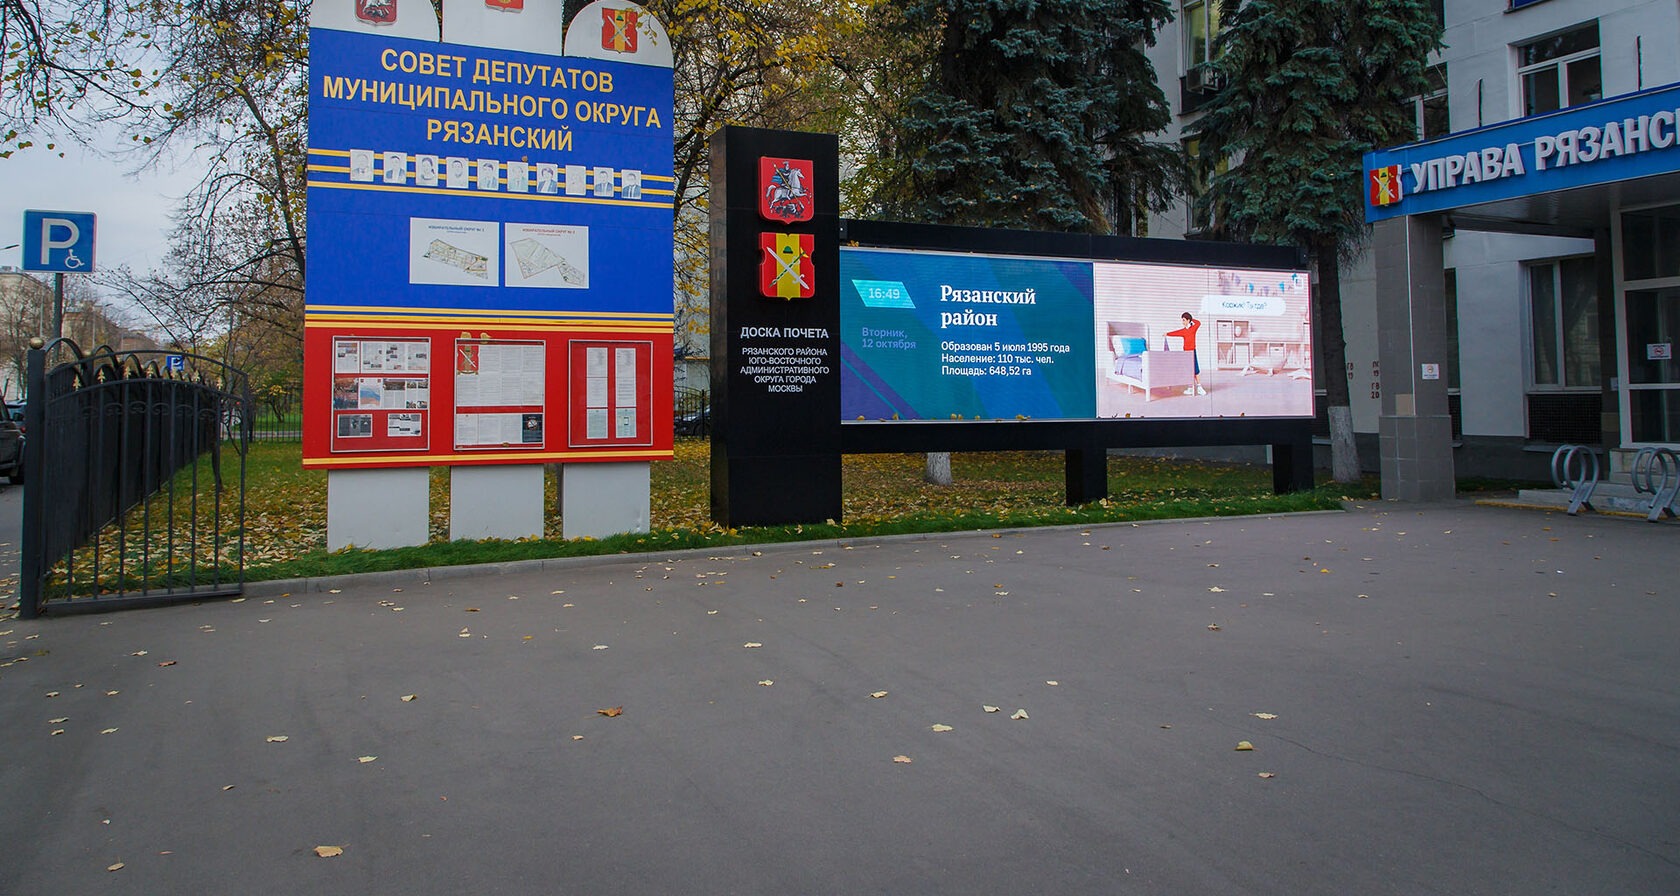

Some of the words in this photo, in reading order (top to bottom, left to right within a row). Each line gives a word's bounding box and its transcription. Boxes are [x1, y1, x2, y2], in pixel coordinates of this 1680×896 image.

[381, 48, 466, 78] СОВЕТ
[473, 58, 613, 93] ДЕПУТАТОВ
[323, 75, 568, 120] МУНИЦИПАЛЬНОГО
[575, 101, 661, 128] ОКРУГА
[427, 119, 572, 151] РЯЗАНСКИЙ
[1410, 143, 1525, 193] УПРАВА
[40, 217, 80, 265] P
[868, 287, 900, 299] 16:49
[940, 285, 1036, 305] Рязанский
[940, 309, 998, 329] район
[740, 326, 781, 339] ДОСКА
[783, 327, 829, 339] ПОЧЕТА
[862, 327, 908, 339] Вторник,
[862, 338, 874, 348] 12
[875, 338, 917, 350] октября
[941, 341, 992, 352] Образован
[994, 342, 1001, 352] 5
[1002, 343, 1026, 352] июля
[1027, 342, 1049, 352] 1995
[1050, 344, 1070, 354] года
[741, 347, 794, 356] РЯЗАНСКОГО
[795, 347, 828, 356] РАЙОНА
[748, 356, 821, 365] ЮГО-ВОСТОЧНОГО
[941, 353, 996, 363] Население:
[997, 354, 1013, 364] 110
[1014, 356, 1034, 364] тыс.
[1035, 356, 1054, 364] чел.
[740, 366, 830, 375] АДМИНИСТРАТИВНОГО
[941, 365, 987, 376] Площадь:
[989, 366, 1020, 376] 648,52
[1022, 367, 1032, 376] га
[754, 375, 784, 384] ОКРУГА
[785, 375, 817, 385] ГОРОДА
[768, 384, 803, 393] МОСКВЫ
